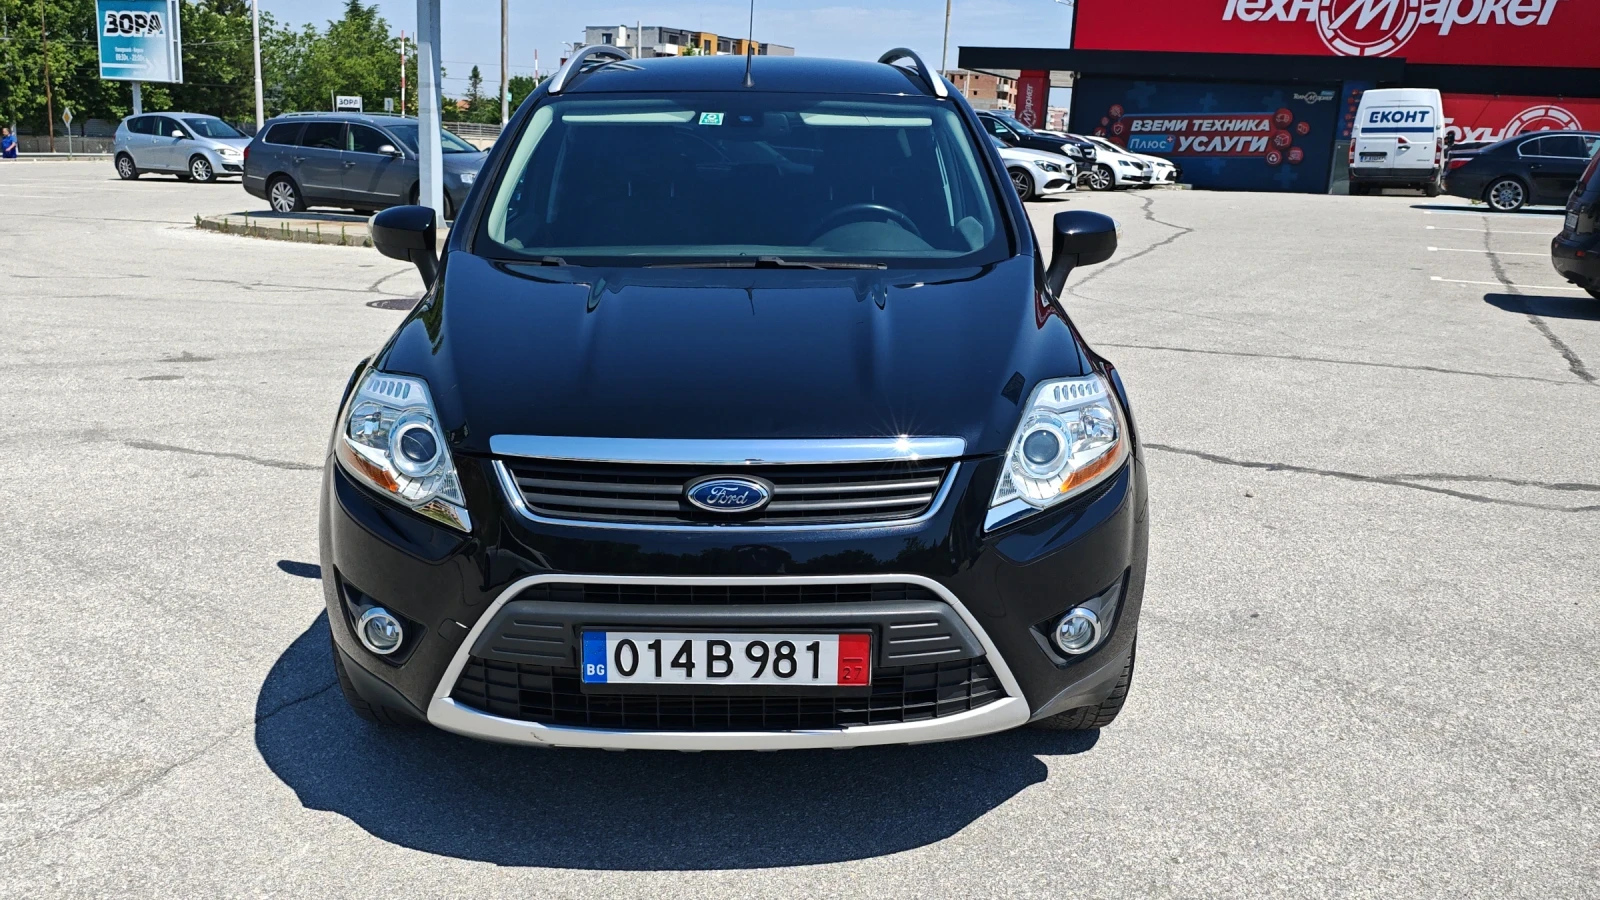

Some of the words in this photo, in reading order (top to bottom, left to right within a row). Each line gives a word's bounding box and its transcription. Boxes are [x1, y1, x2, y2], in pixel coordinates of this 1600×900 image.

[104, 11, 164, 36] ЗОРА
[1369, 110, 1430, 123] ЕКОНТ
[1130, 119, 1189, 132] ВЗЕМИ
[1192, 119, 1270, 132] ТЕХНИКА
[1178, 135, 1269, 152] УСЛУГИ
[706, 486, 749, 504] Ford
[586, 663, 605, 676] BG
[843, 666, 863, 680] 27
